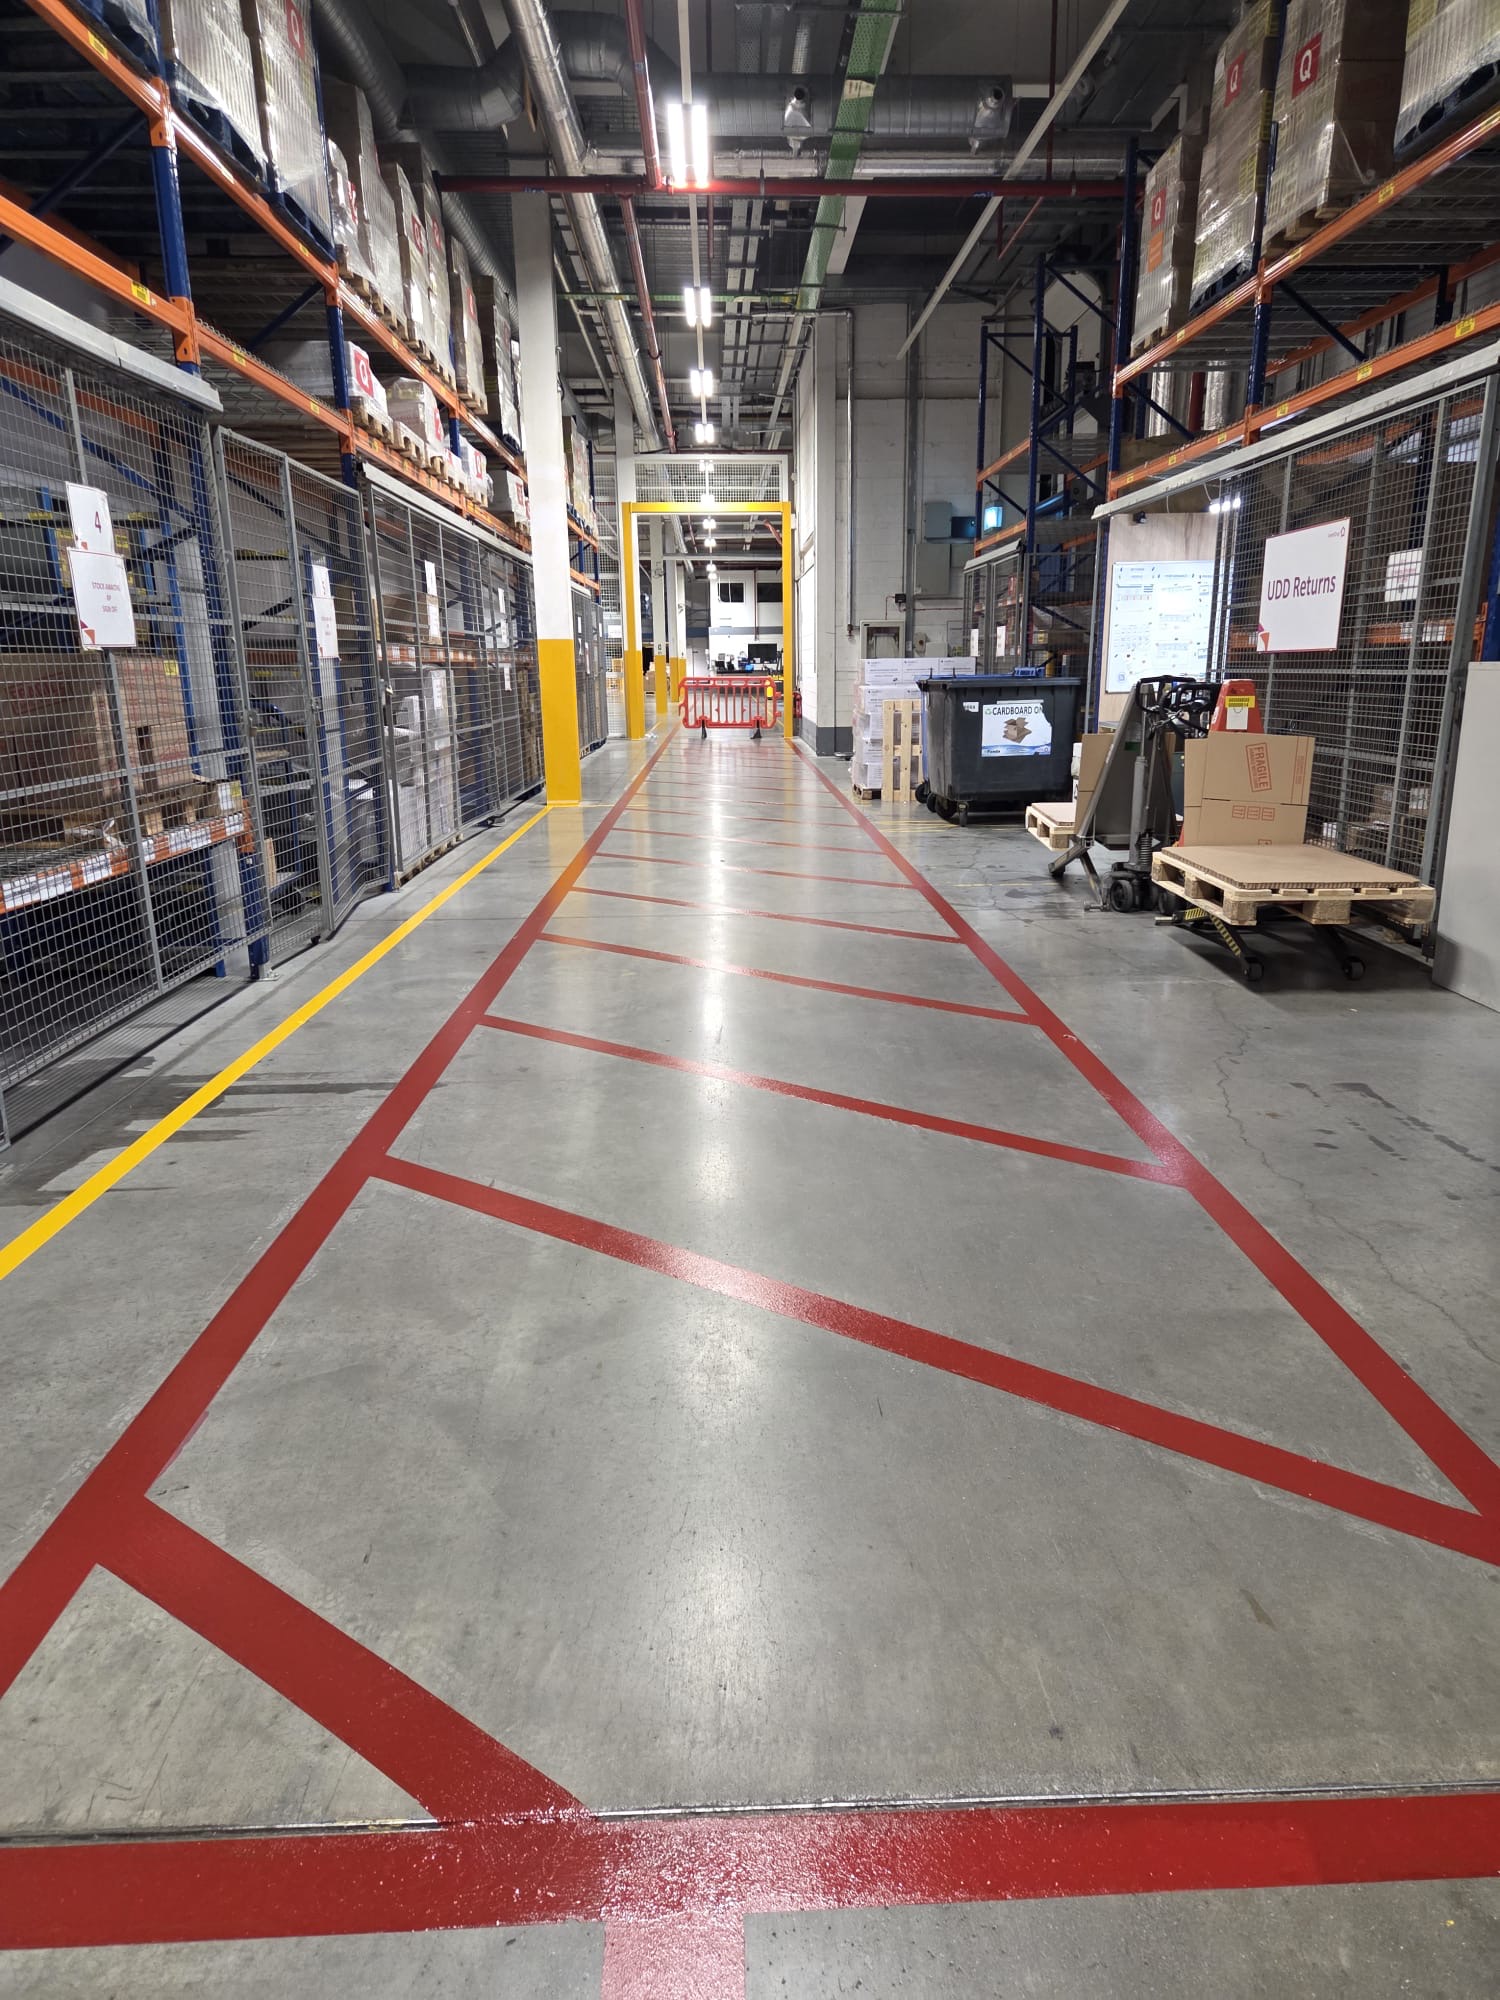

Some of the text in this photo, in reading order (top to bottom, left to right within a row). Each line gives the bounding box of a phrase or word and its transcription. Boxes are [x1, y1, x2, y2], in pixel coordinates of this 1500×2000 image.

[1230, 64, 1239, 93] Q
[1300, 49, 1312, 82] Q
[1154, 197, 1162, 221] Q
[360, 360, 370, 390] Q
[94, 511, 101, 533] 4
[1268, 575, 1336, 600] UDD Returns
[992, 706, 1033, 715] CARDBOARD
[1254, 747, 1268, 790] FRAGILE
